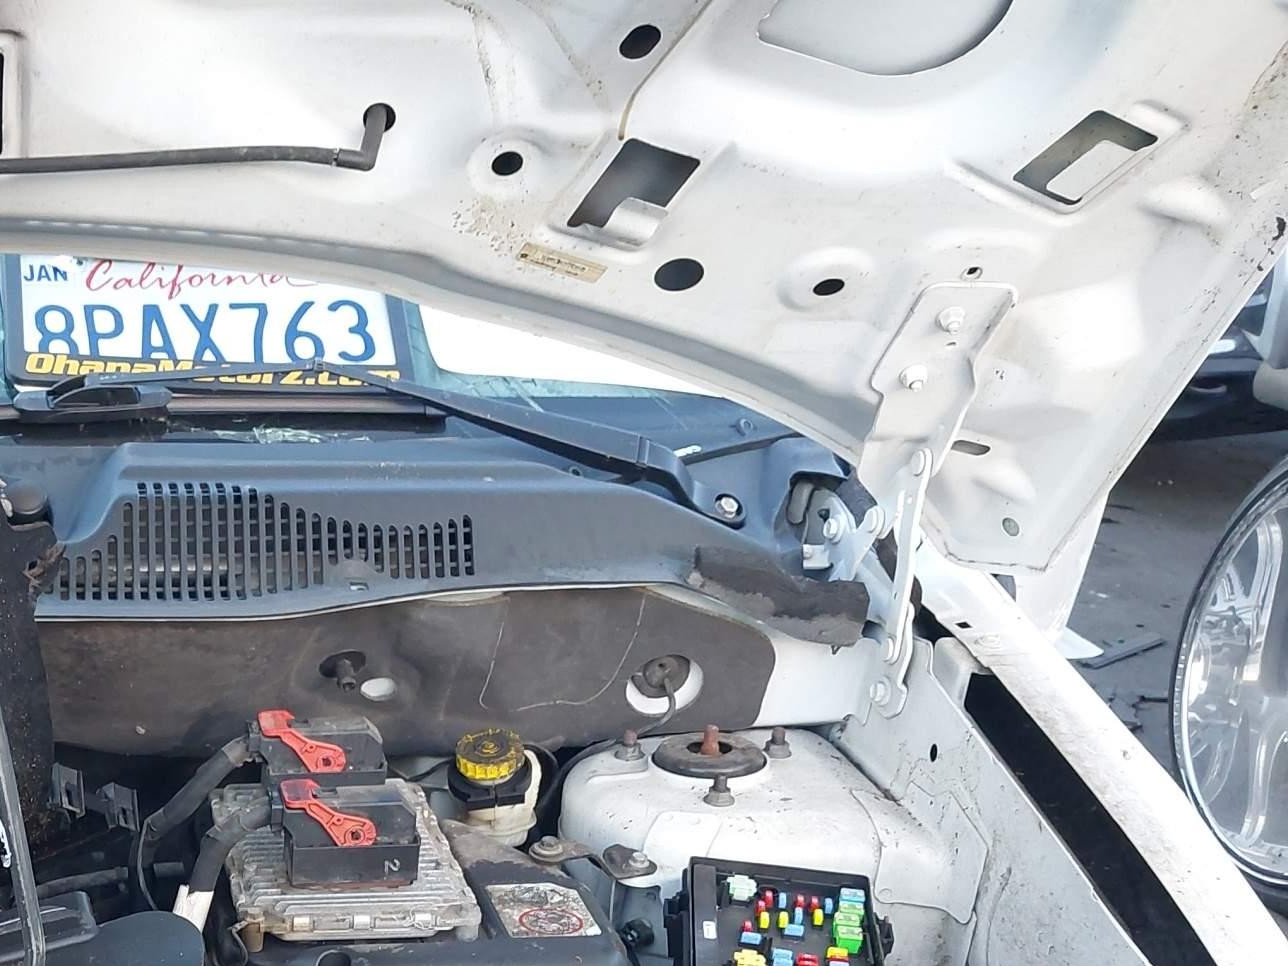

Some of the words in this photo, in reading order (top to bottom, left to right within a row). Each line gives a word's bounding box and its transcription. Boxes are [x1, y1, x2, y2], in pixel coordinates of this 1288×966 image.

[24, 264, 69, 282] JAN
[85, 259, 318, 300] California
[34, 299, 376, 364] 8PAX763
